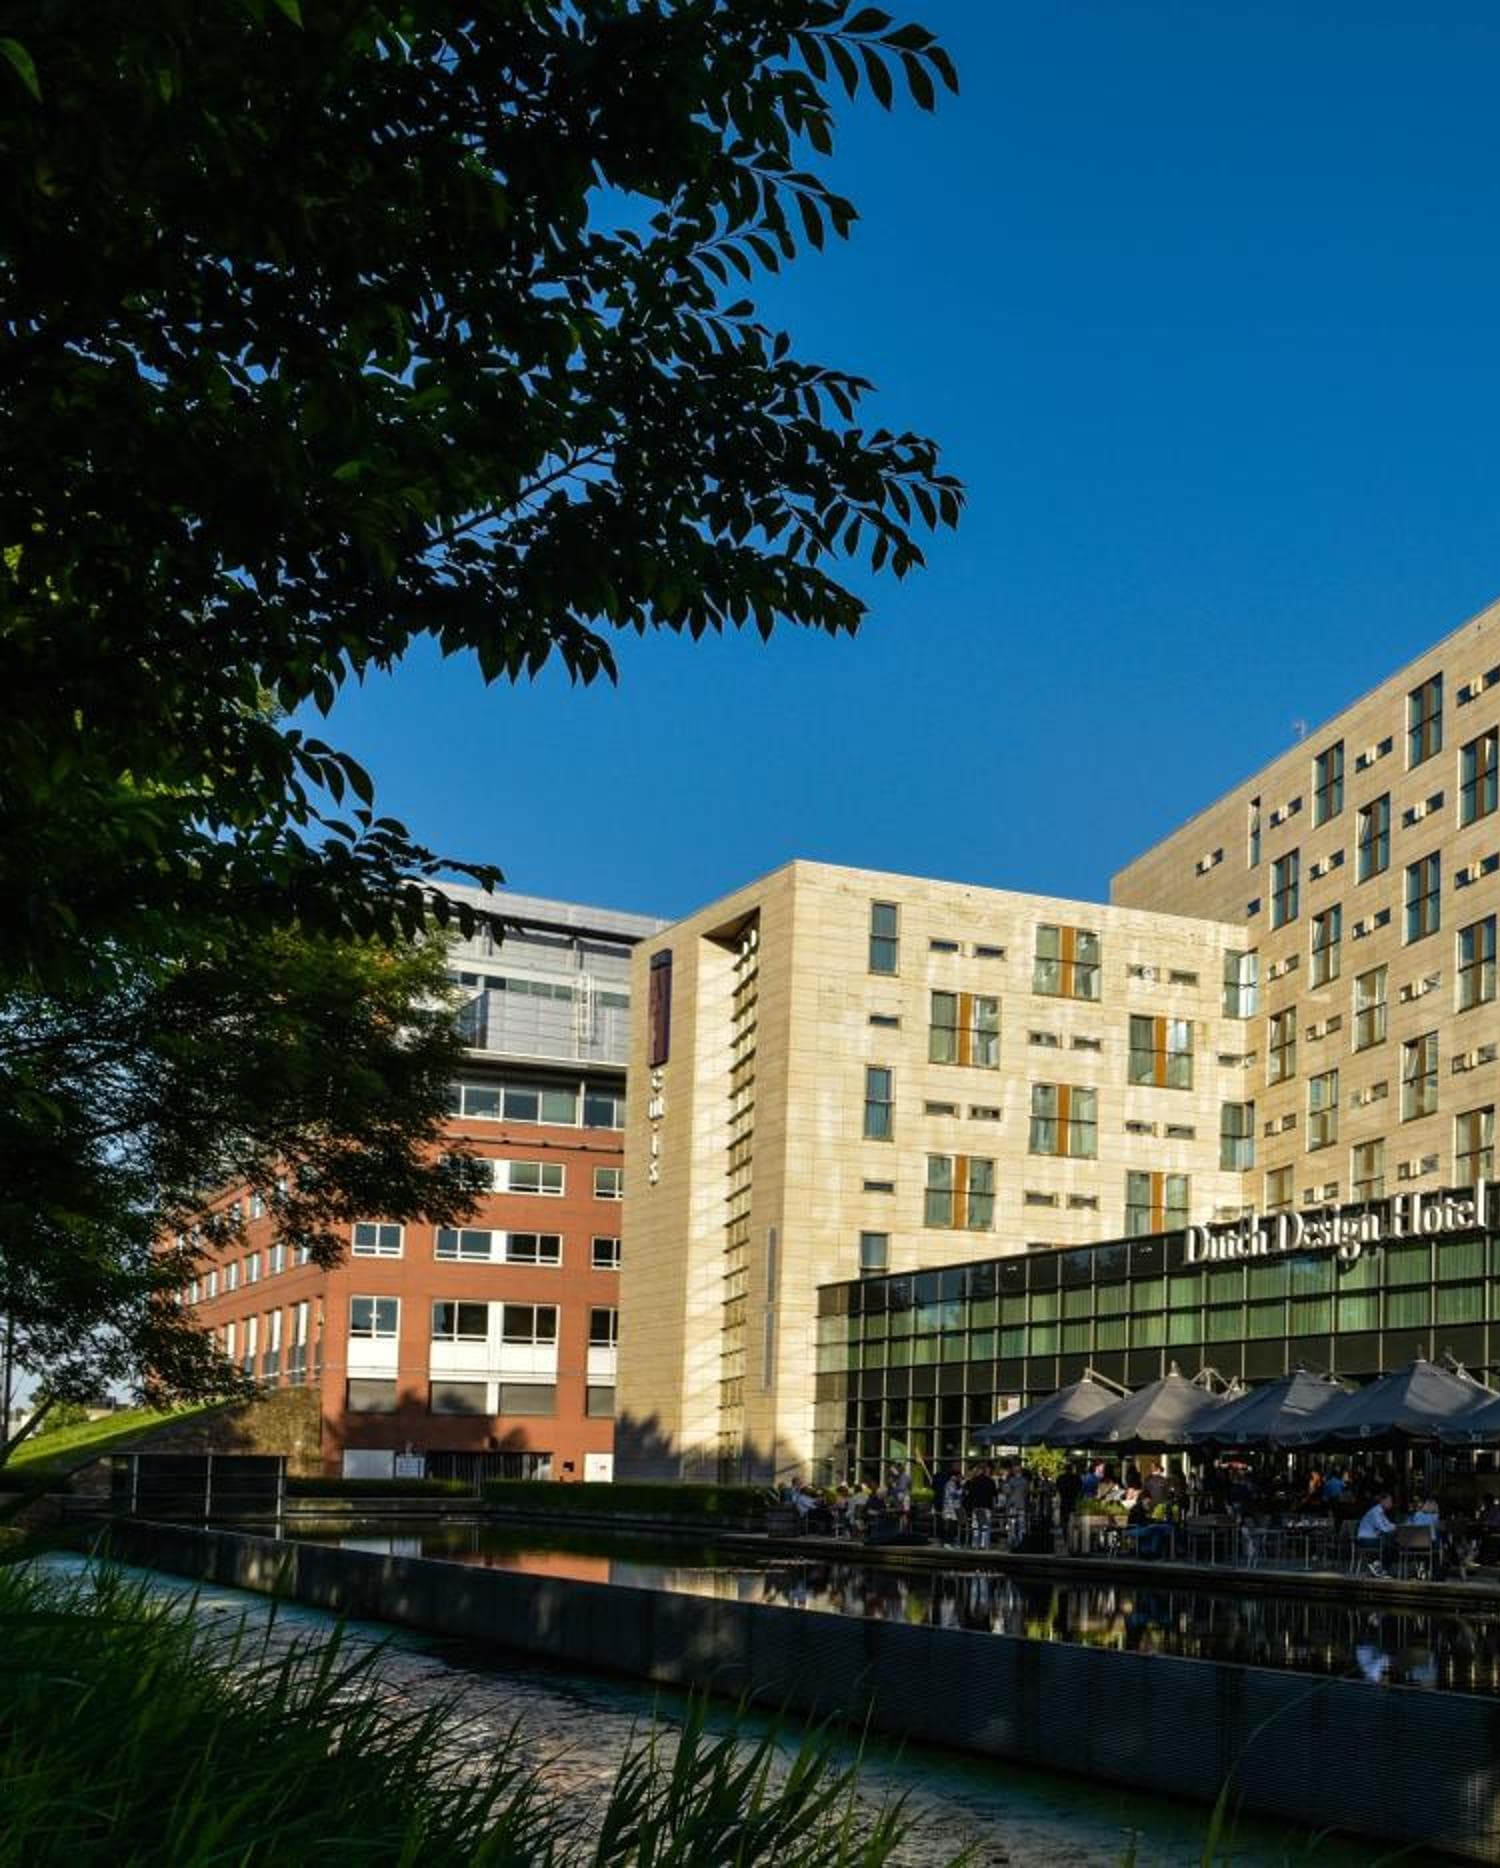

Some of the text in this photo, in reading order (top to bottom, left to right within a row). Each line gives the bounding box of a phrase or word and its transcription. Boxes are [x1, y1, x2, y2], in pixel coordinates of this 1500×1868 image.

[1185, 1177, 1487, 1264] Dutch Design Hotel
